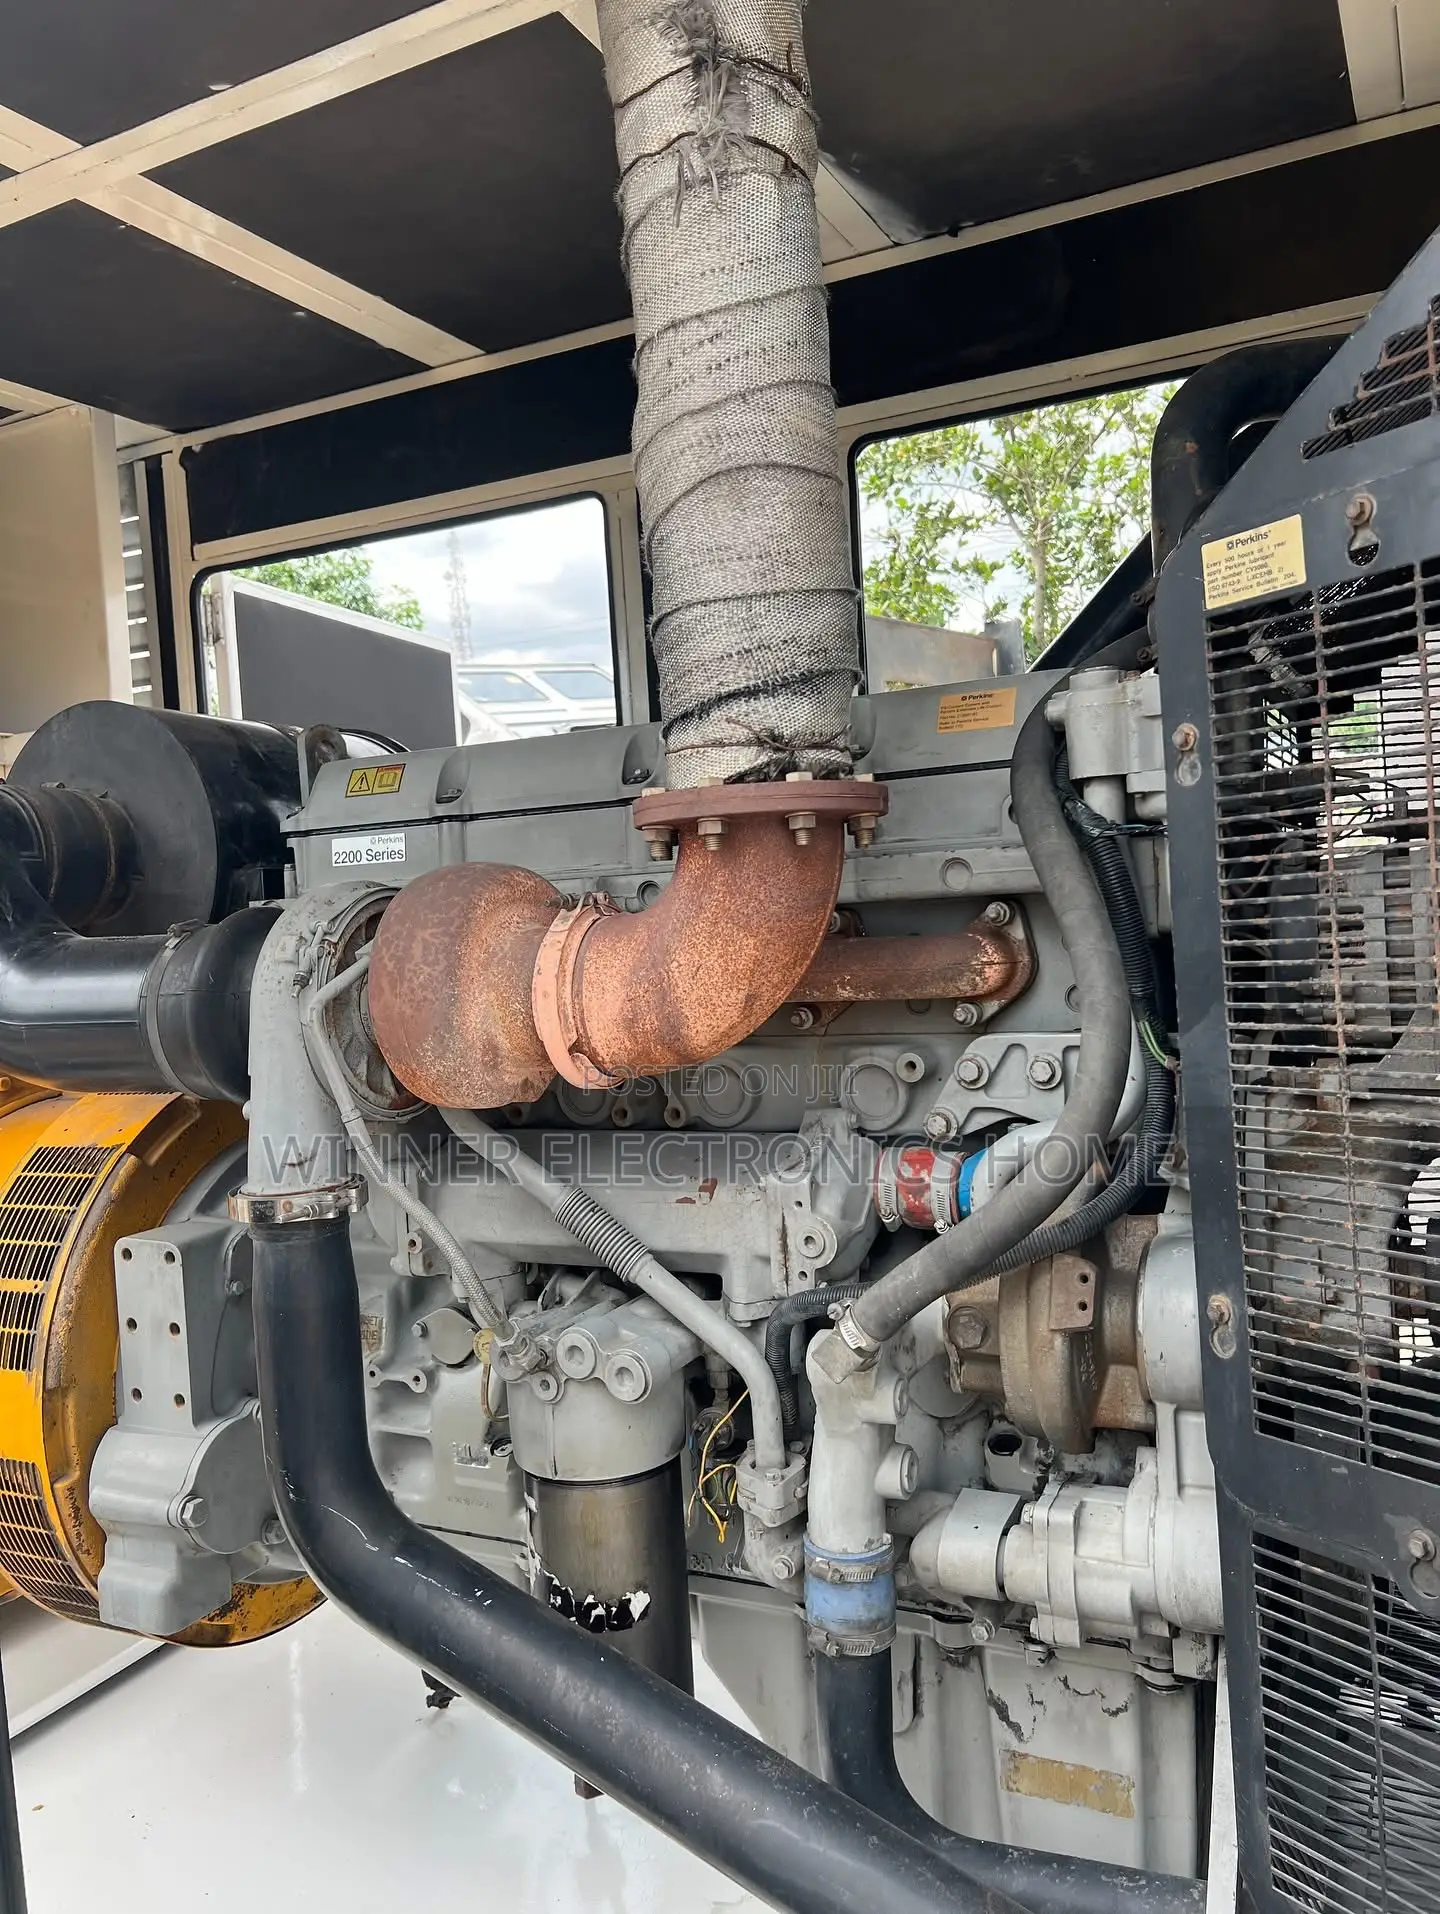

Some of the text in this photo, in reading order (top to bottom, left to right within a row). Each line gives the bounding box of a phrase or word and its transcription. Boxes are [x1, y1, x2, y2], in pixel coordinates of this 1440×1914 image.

[1235, 532, 1269, 548] Perkins
[377, 836, 404, 845] Perkins
[334, 847, 404, 864] 2200 Series
